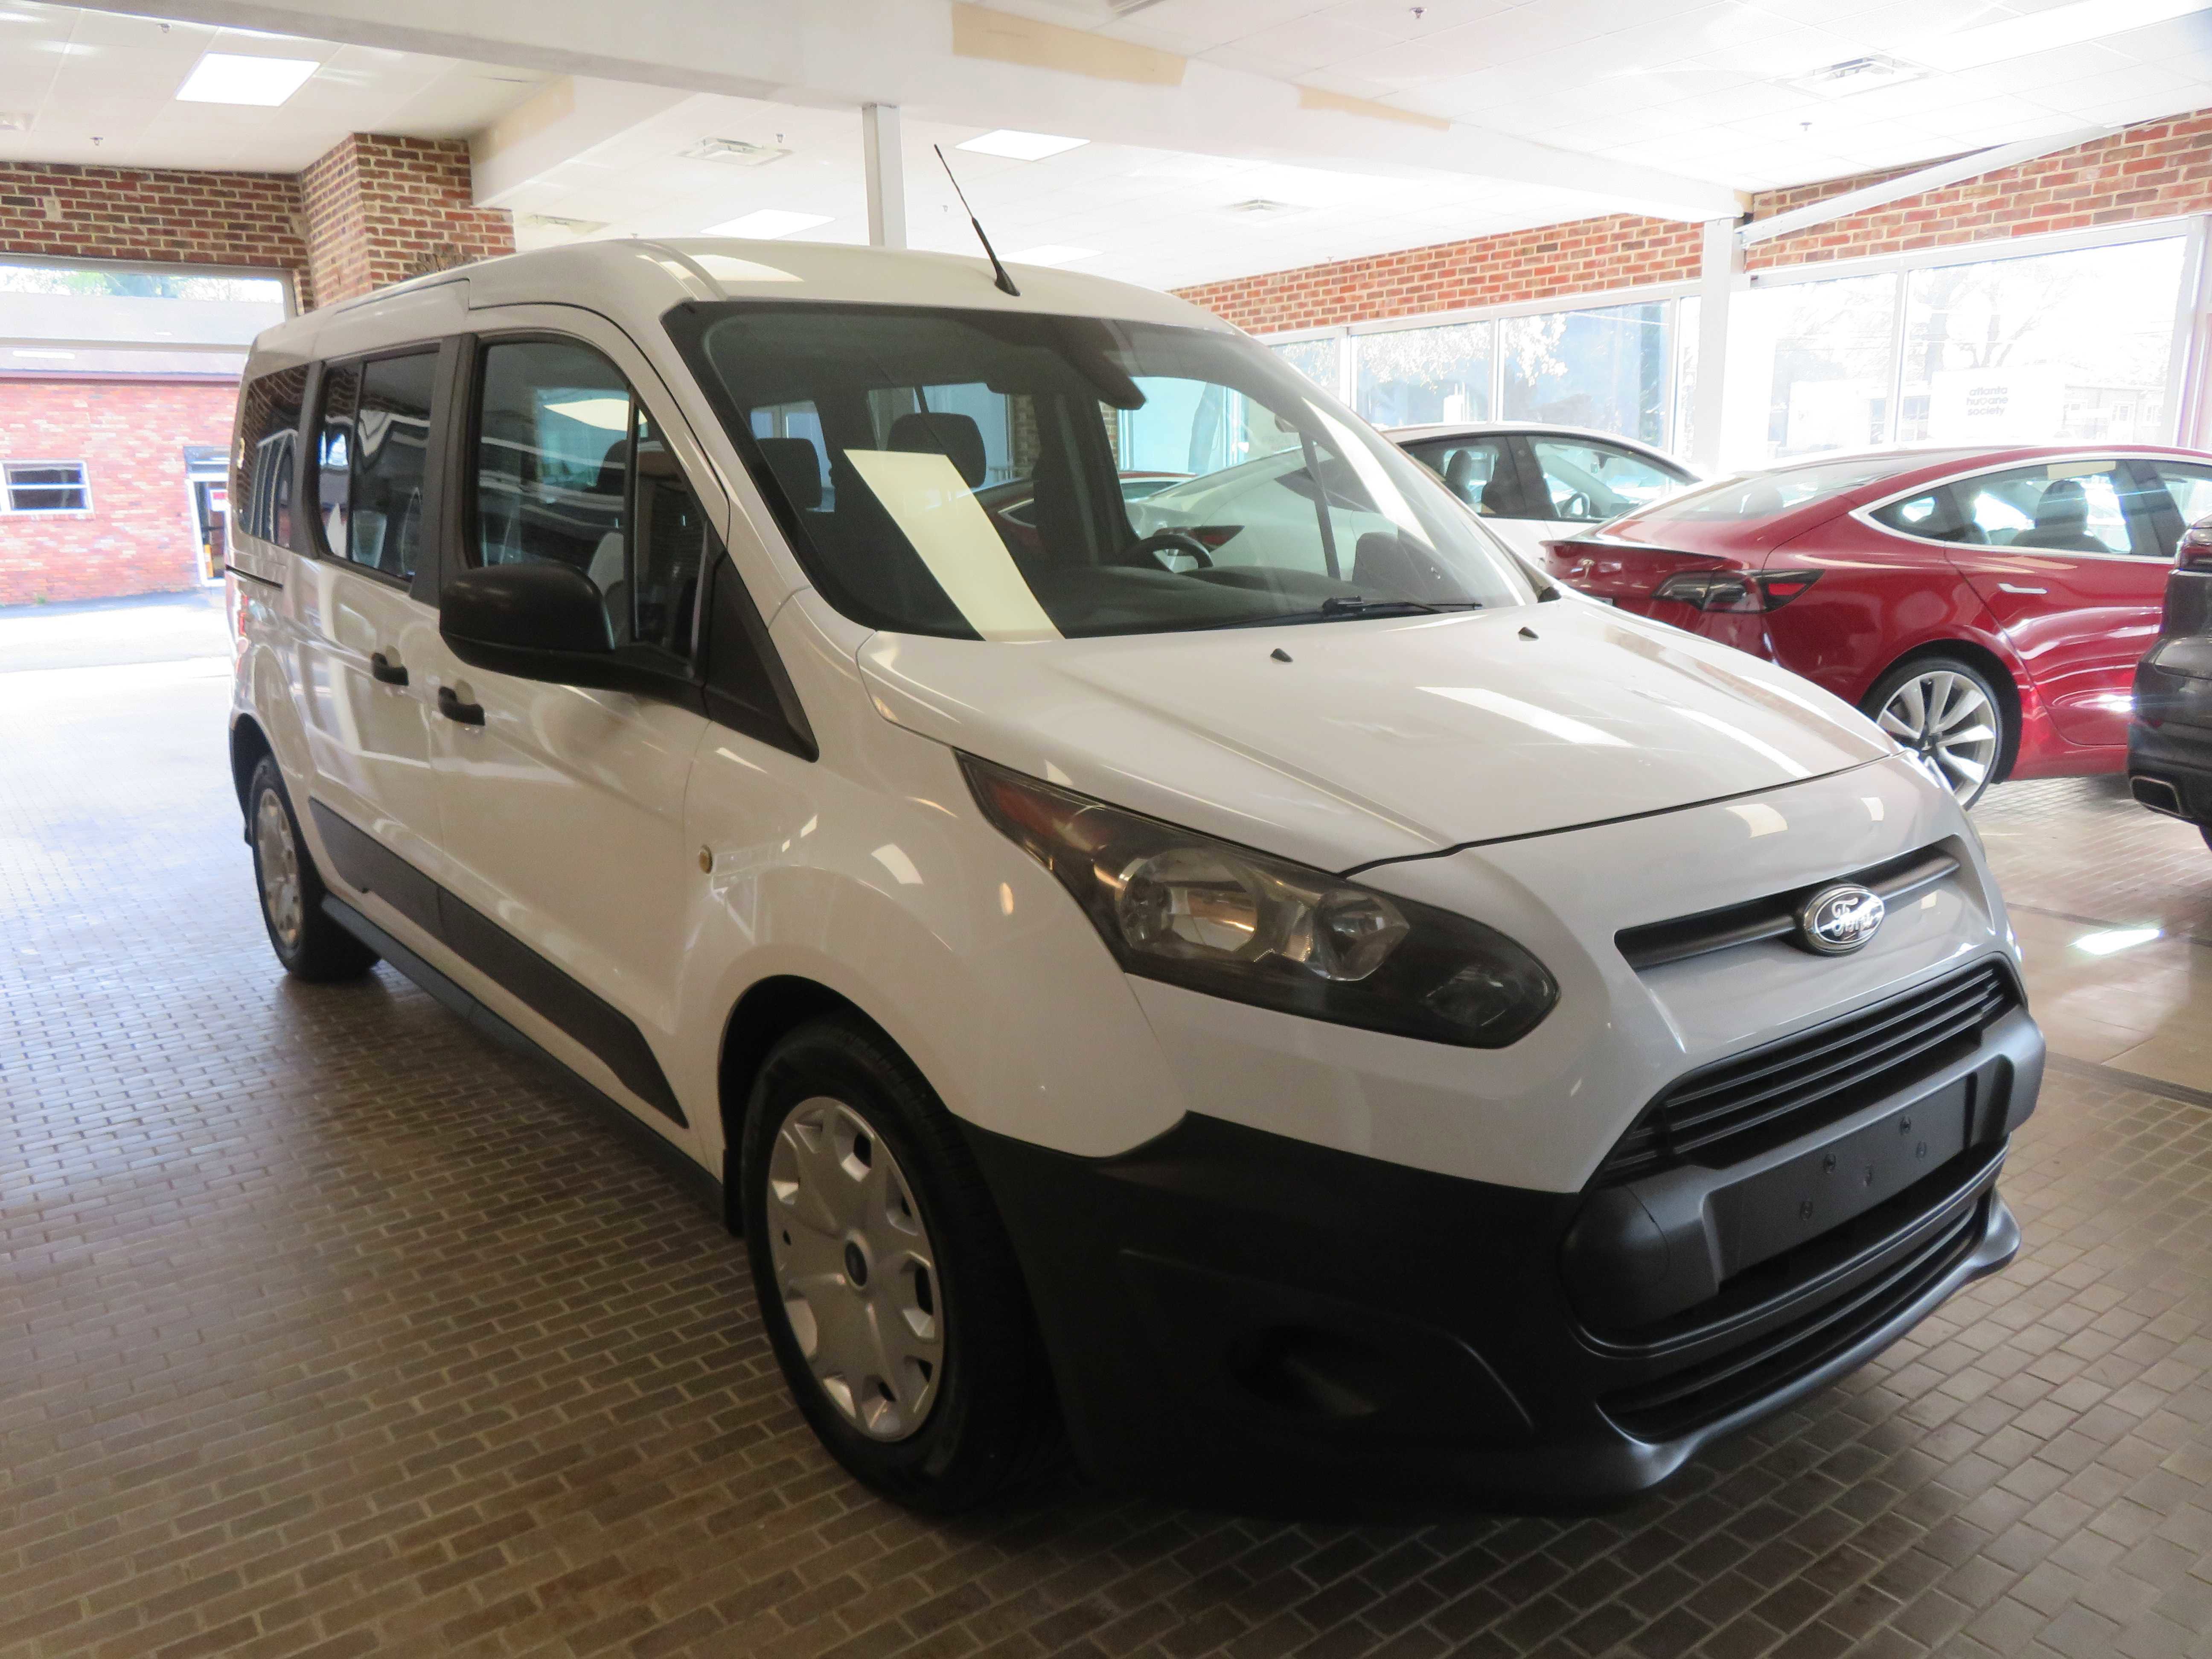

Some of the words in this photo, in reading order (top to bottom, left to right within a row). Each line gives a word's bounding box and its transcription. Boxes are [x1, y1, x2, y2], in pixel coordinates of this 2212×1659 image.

[1970, 386, 2007, 396] atlanta
[1968, 405, 2005, 416] society
[1831, 896, 1878, 937] Ford
